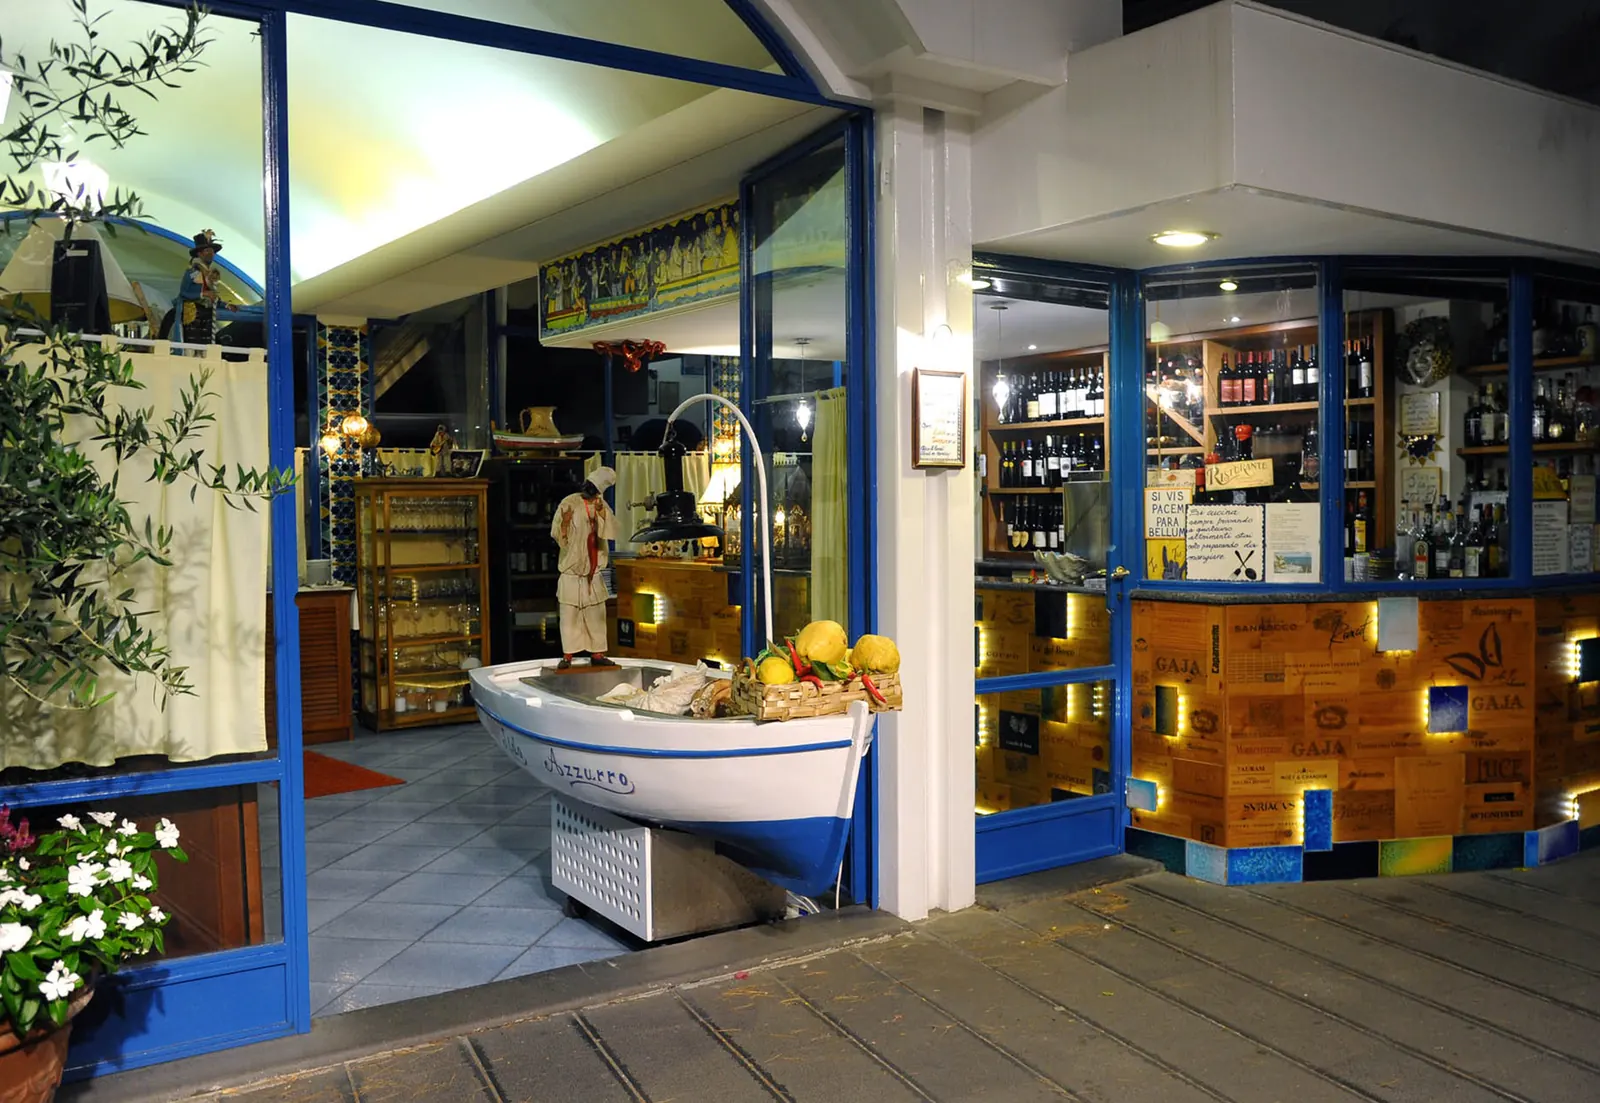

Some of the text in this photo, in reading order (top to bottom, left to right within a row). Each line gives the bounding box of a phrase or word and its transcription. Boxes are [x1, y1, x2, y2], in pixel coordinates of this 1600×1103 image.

[1151, 491, 1184, 502] SI VIS
[1151, 504, 1185, 514] PACEM
[1156, 517, 1180, 527] PARA
[1148, 527, 1188, 538] BELLUM
[1155, 656, 1201, 676] GAJA
[1471, 694, 1525, 712] GAJA
[1291, 739, 1348, 758] GAJA
[543, 746, 629, 787] Azzurro
